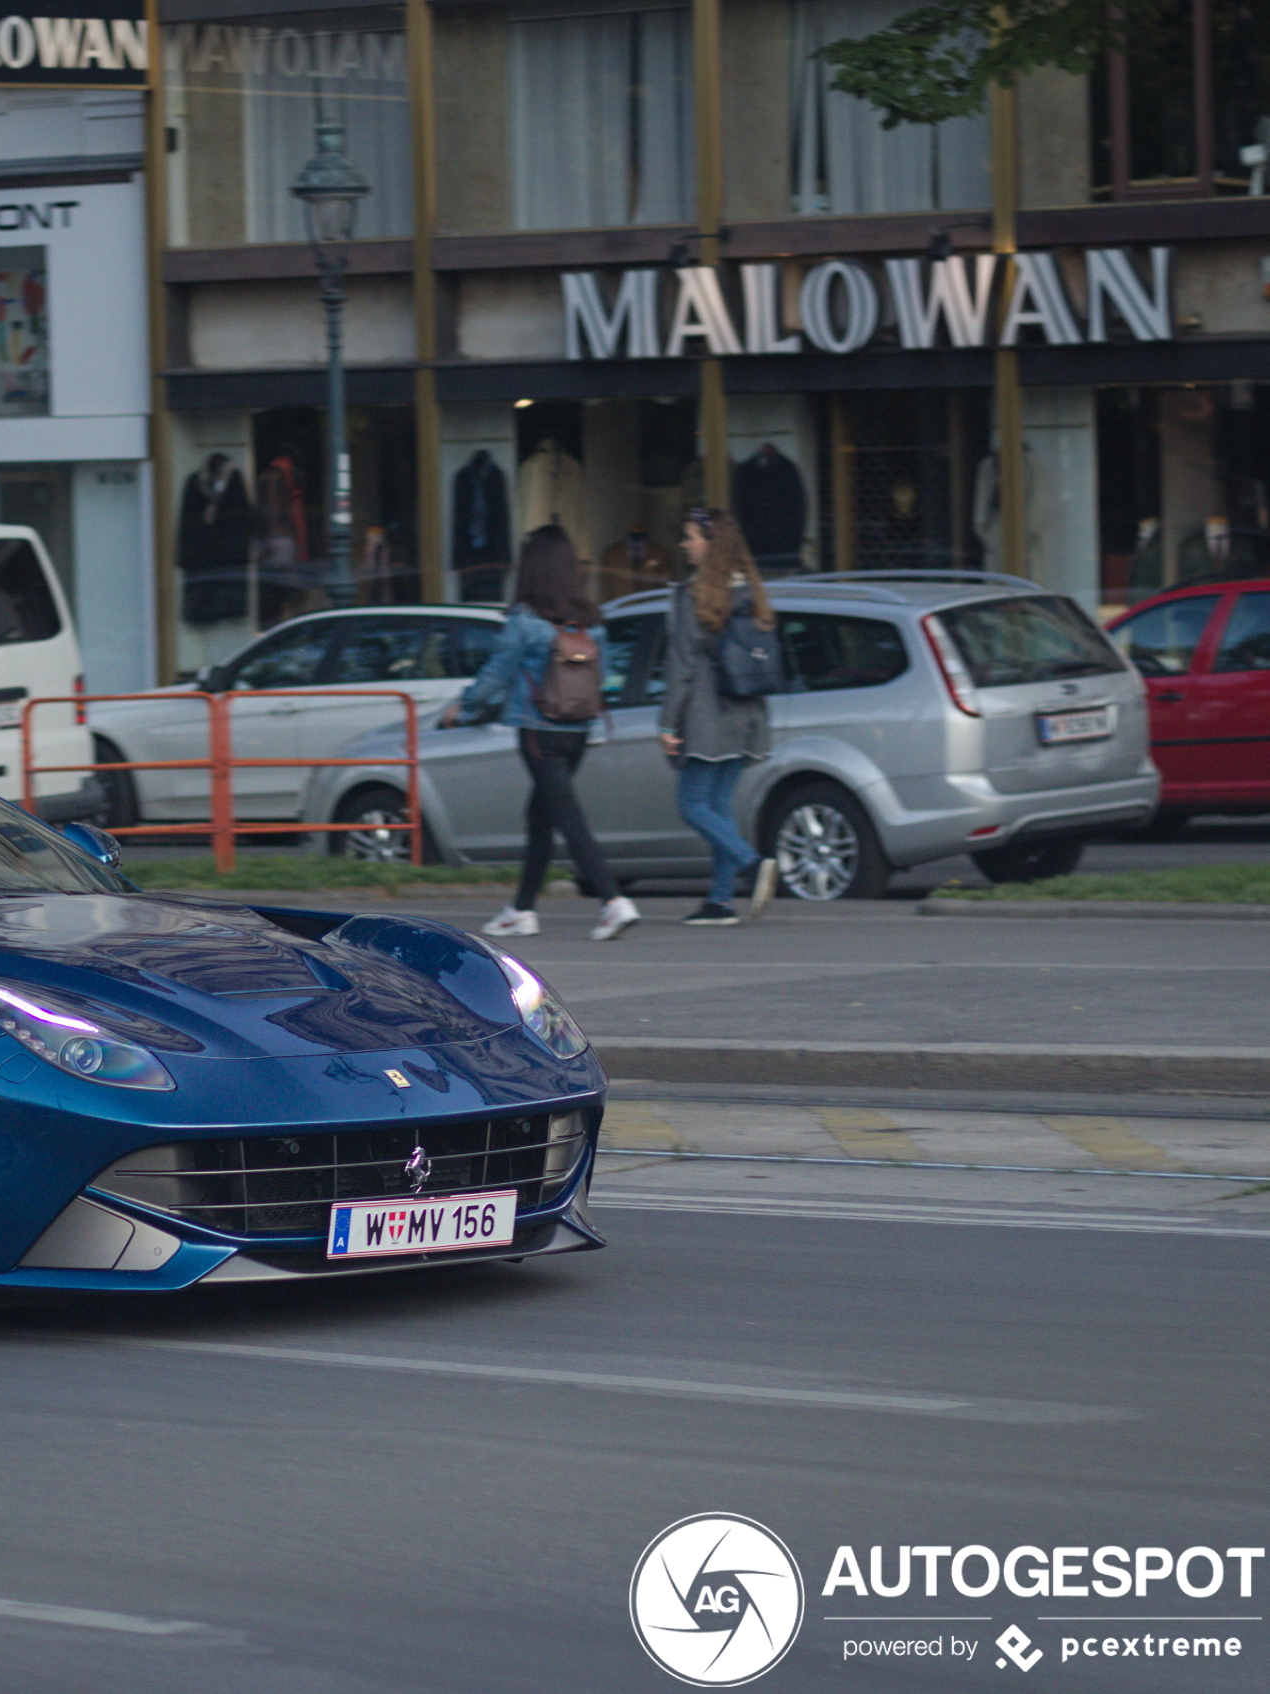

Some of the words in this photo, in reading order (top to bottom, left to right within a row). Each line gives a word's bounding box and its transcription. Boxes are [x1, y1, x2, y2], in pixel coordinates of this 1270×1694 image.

[561, 248, 1173, 360] MALOWAN
[336, 1236, 345, 1247] A
[366, 1212, 386, 1246] W
[408, 1208, 444, 1243] MV
[452, 1203, 496, 1239] 156
